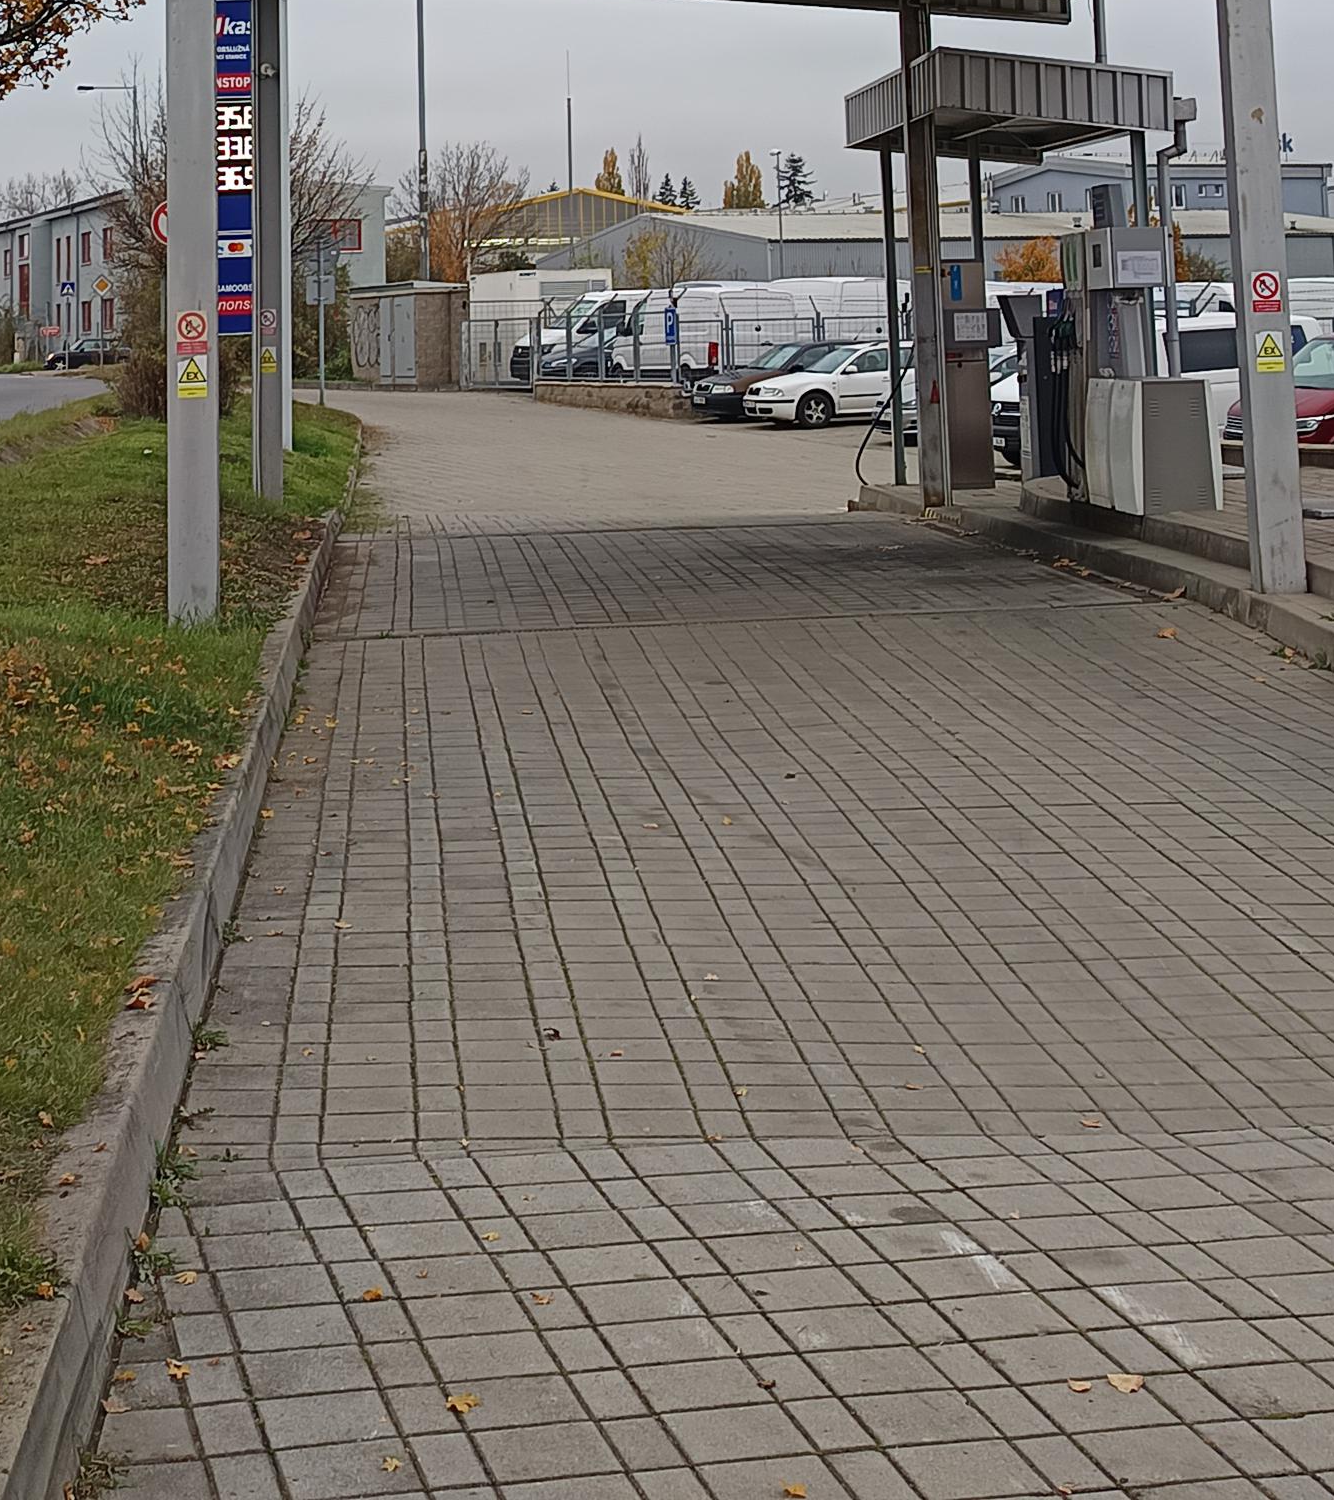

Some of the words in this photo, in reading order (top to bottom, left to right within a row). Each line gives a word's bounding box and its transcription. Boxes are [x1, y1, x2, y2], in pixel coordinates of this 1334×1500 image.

[218, 300, 252, 311] nons
[667, 312, 673, 333] P
[1264, 346, 1276, 355] EX
[187, 371, 199, 380] EX
